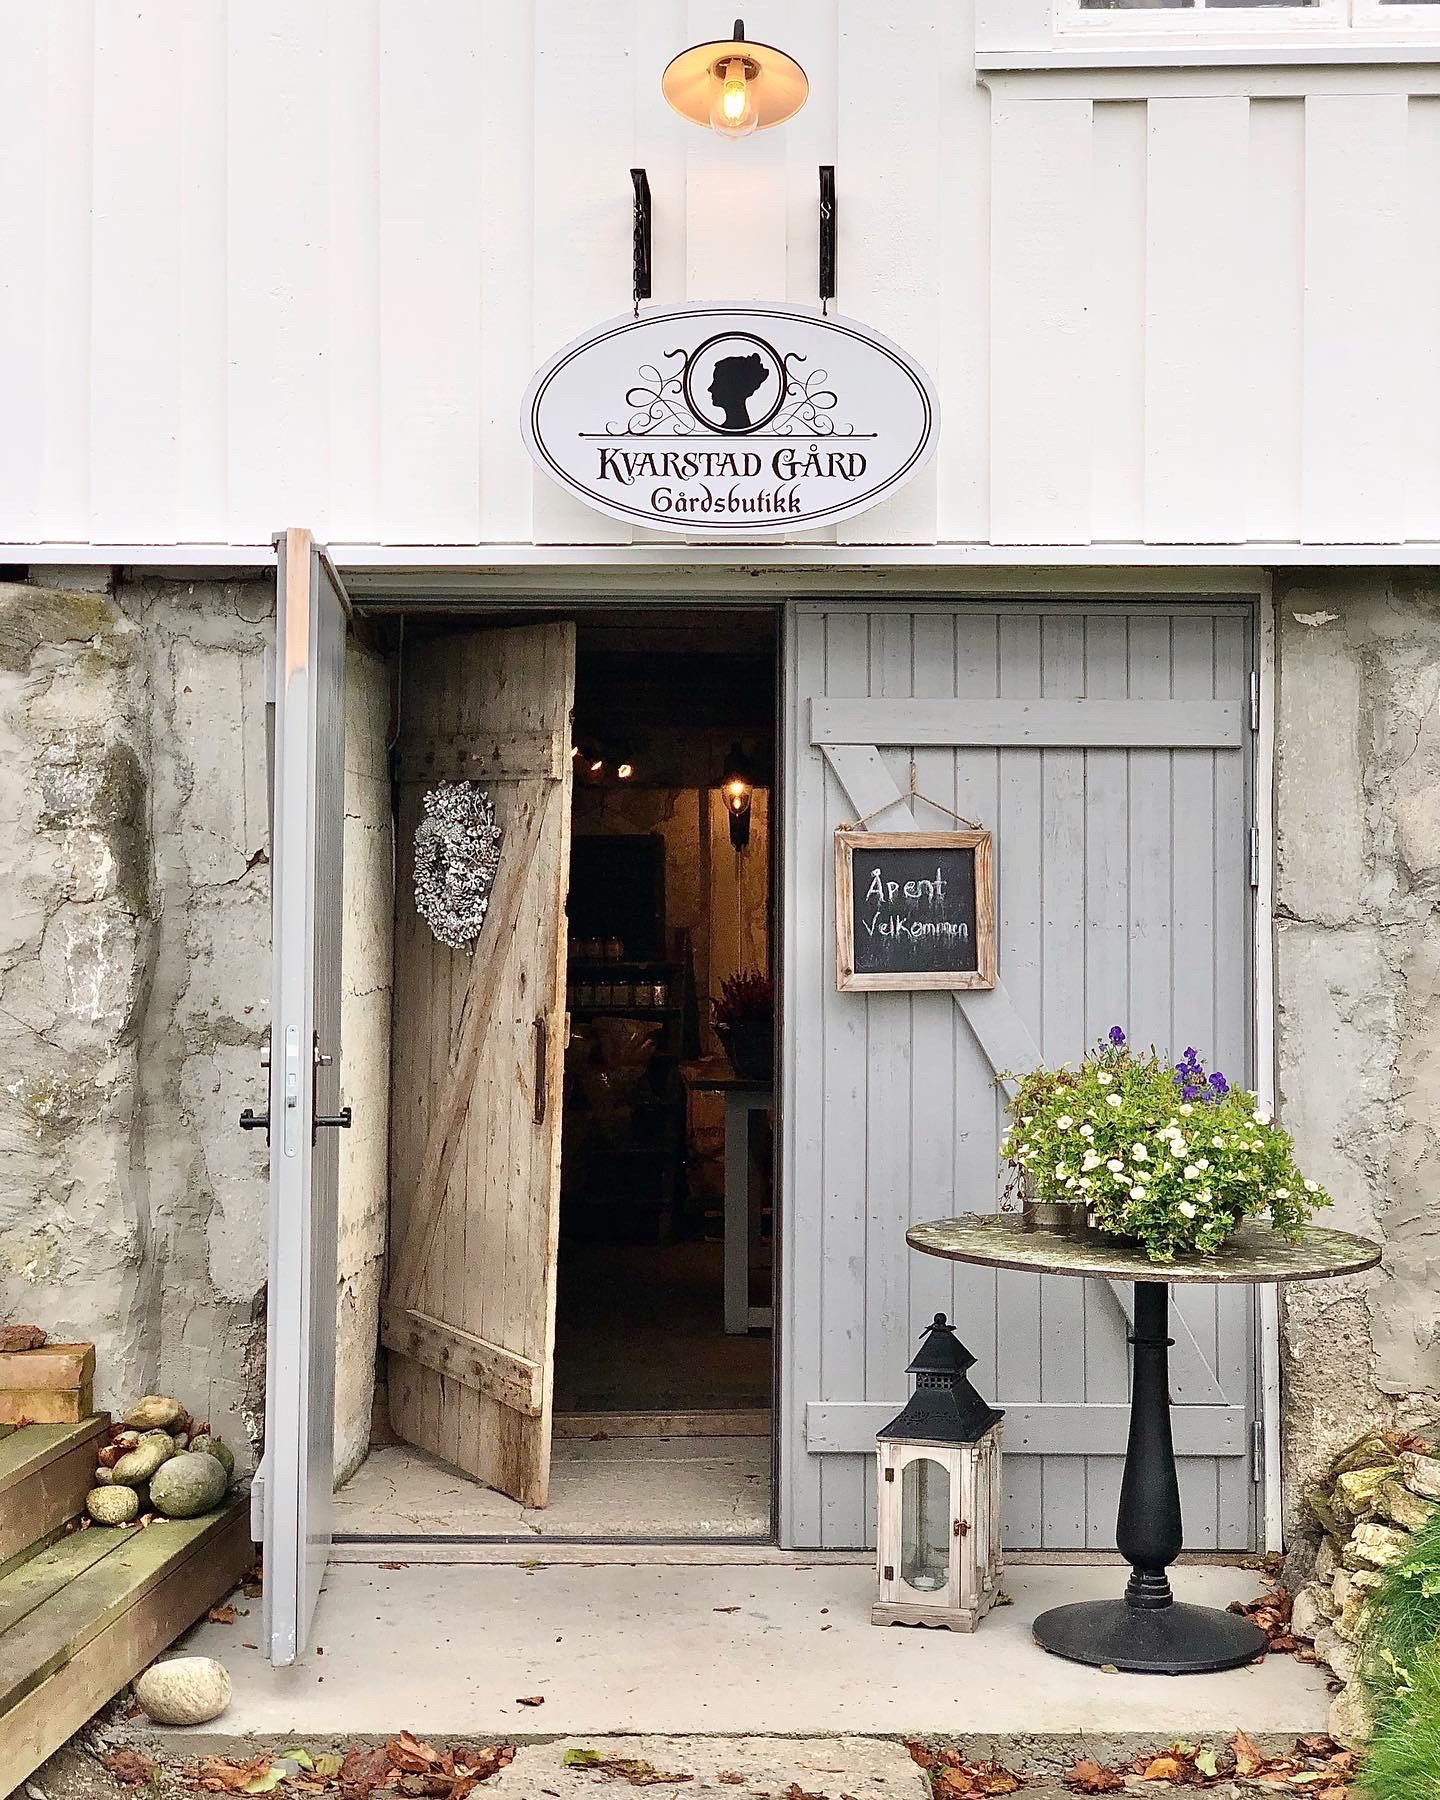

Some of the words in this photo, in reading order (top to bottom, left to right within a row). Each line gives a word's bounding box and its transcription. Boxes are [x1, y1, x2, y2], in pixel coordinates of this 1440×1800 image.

[597, 447, 762, 485] KVARSTAD
[772, 444, 867, 481] GÅRD
[651, 483, 801, 513] Gårdsbutikk
[865, 868, 947, 903] Åpent
